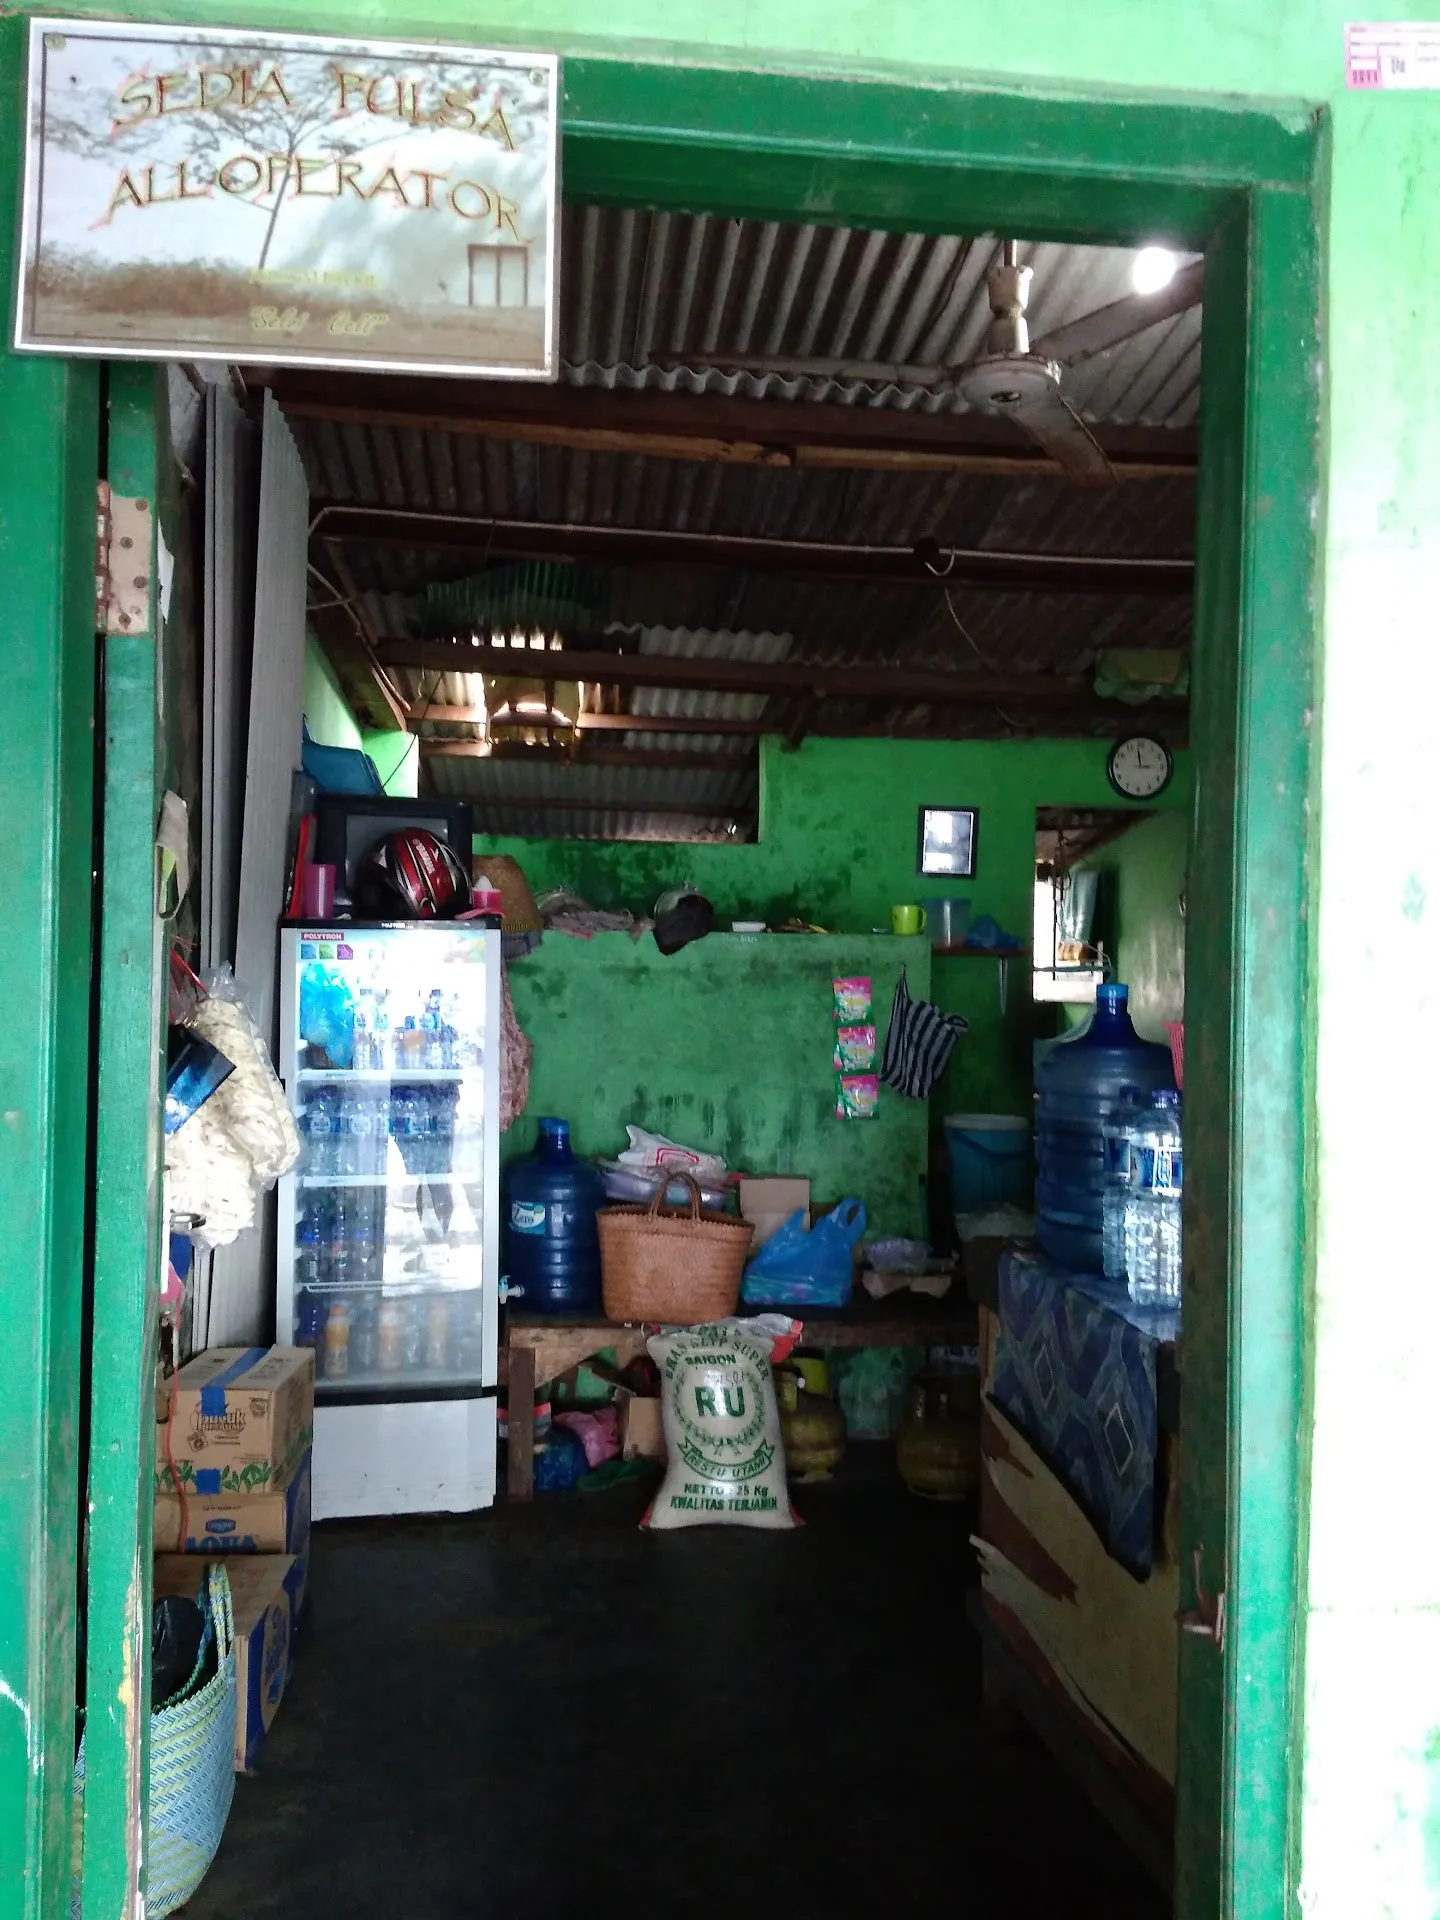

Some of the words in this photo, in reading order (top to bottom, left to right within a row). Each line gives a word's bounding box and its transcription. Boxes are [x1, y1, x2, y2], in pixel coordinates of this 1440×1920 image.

[112, 62, 293, 134] SEDIA
[331, 62, 514, 151] PULSA
[685, 1353, 737, 1366] SAIGON
[731, 1340, 770, 1381] SUPER
[694, 1386, 746, 1418] RU
[684, 1482, 724, 1496] NETTO
[670, 1495, 725, 1511] KWALITAS
[727, 1496, 778, 1512] TERJAMIN
